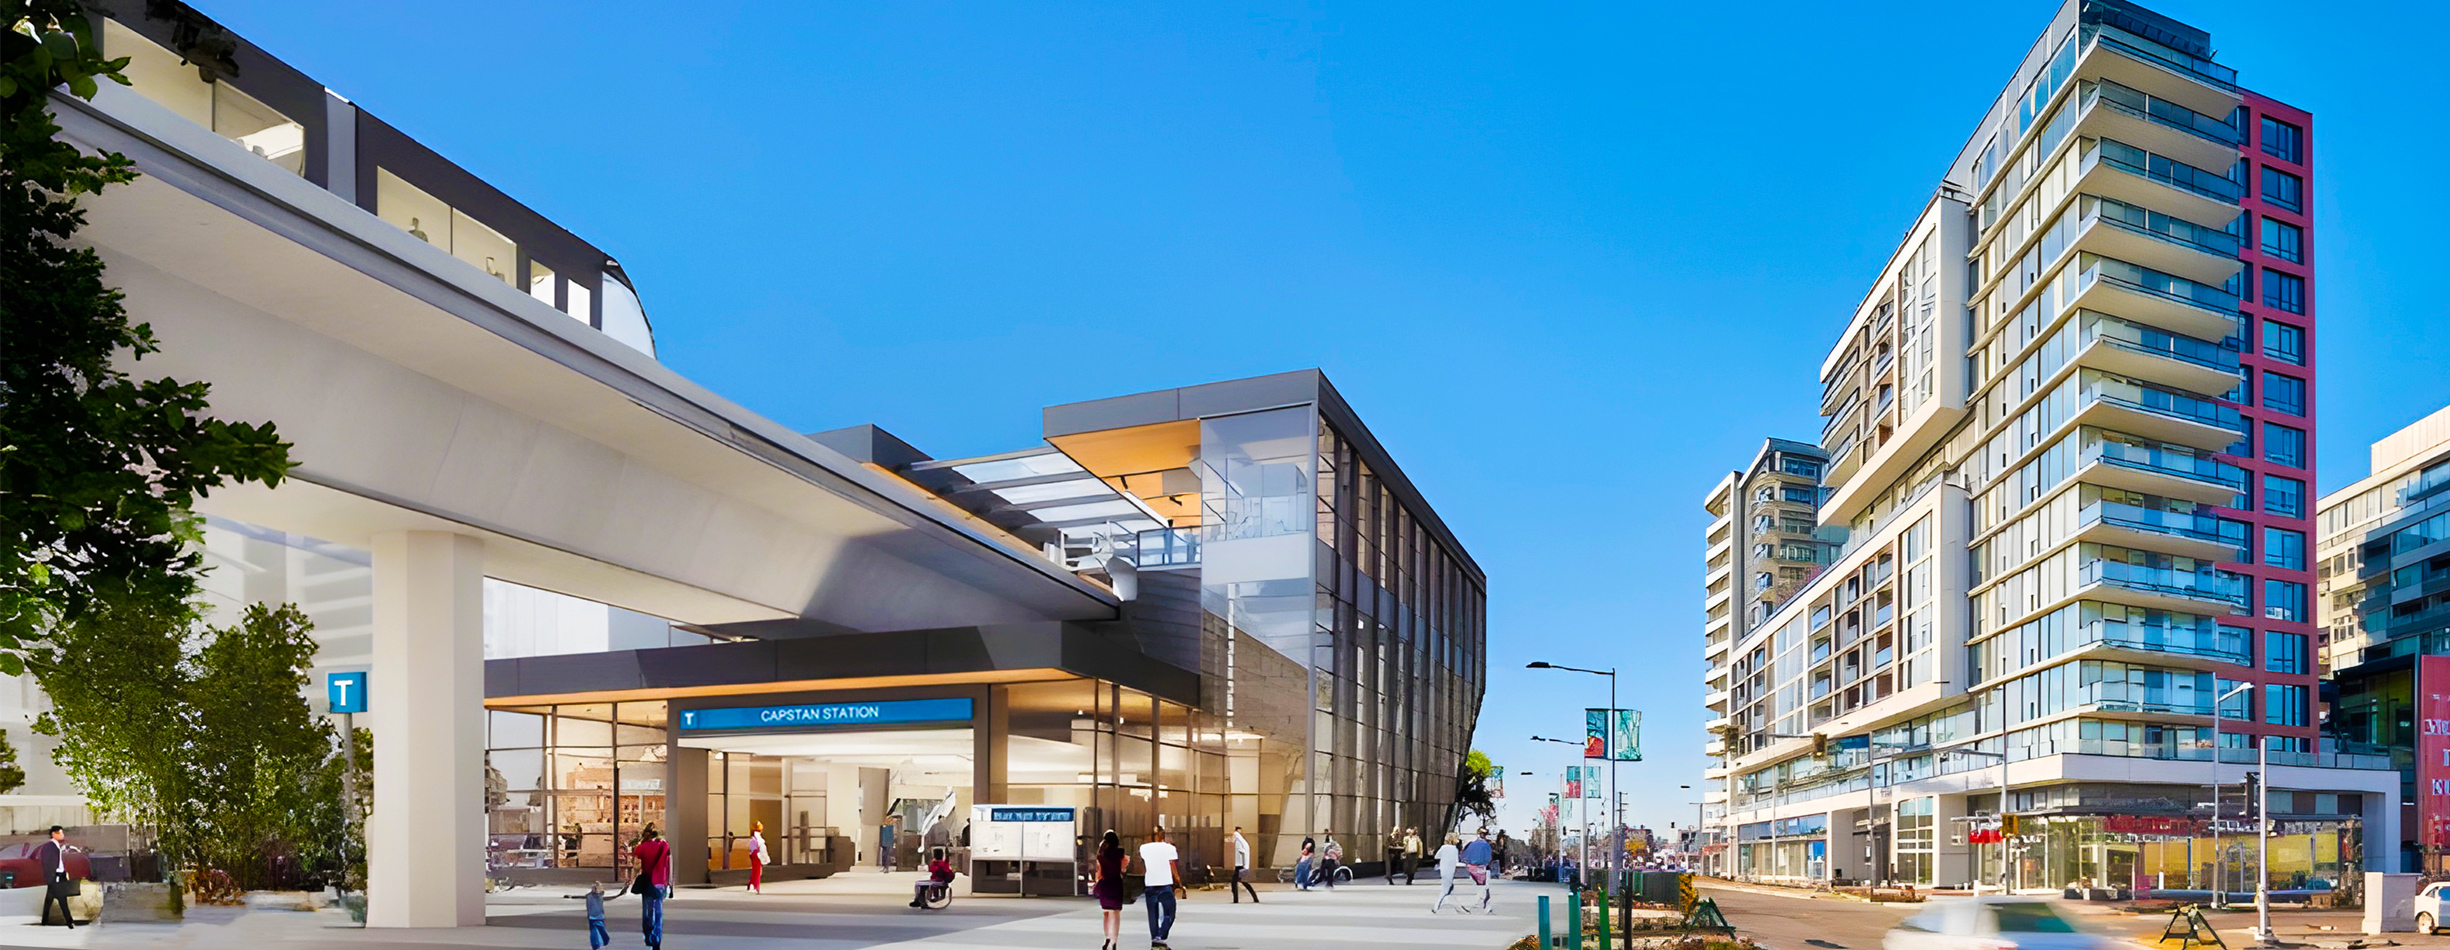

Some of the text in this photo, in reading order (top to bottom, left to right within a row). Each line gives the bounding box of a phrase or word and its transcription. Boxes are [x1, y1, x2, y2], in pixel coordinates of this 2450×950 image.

[334, 680, 353, 706] T
[685, 713, 694, 725] T
[761, 706, 879, 722] CAPSTAN STATION
